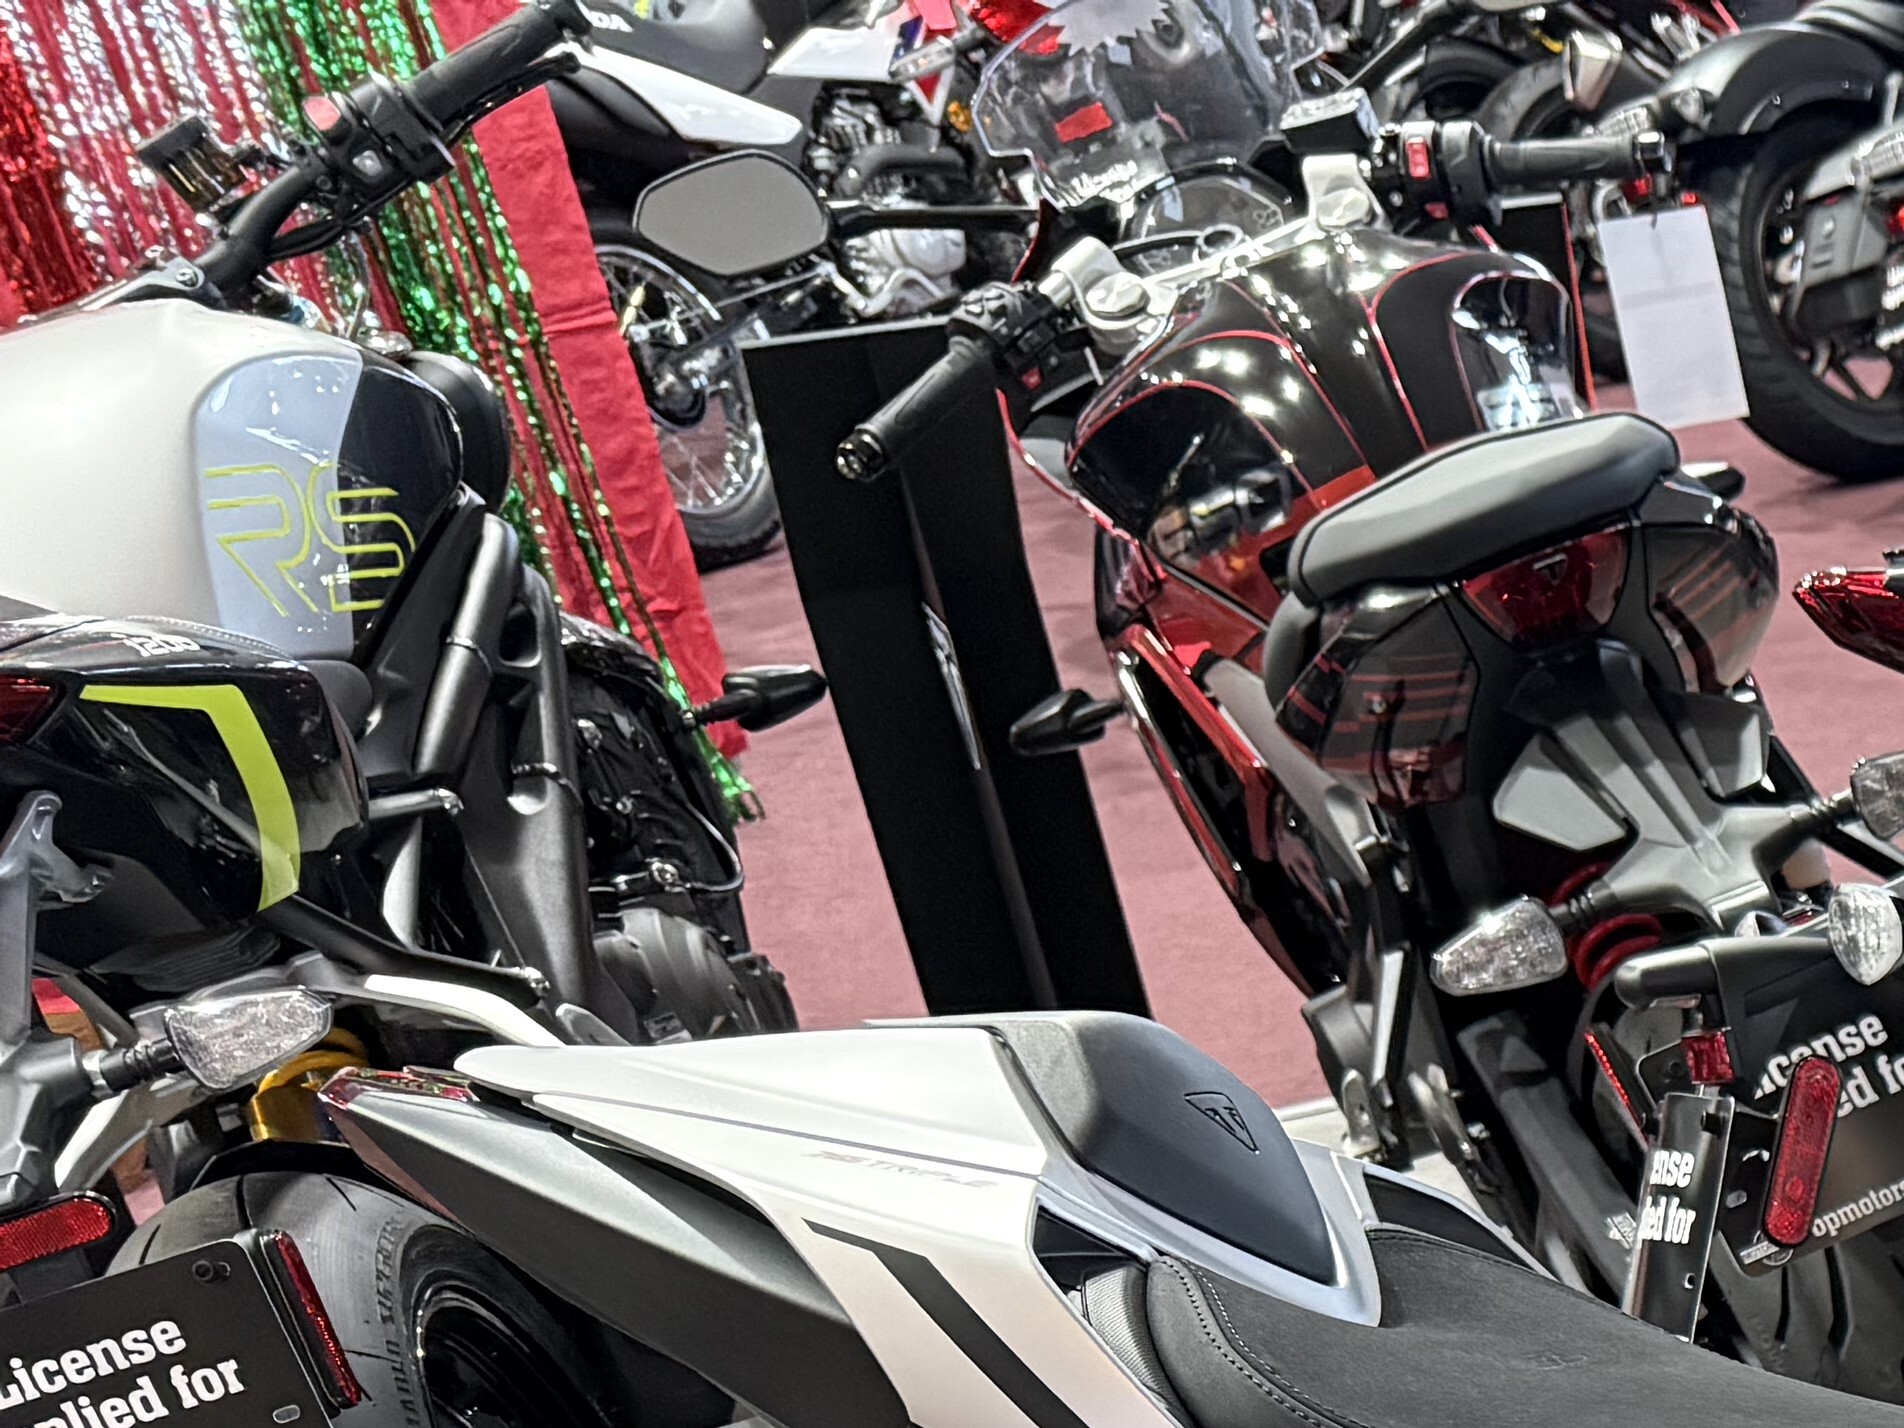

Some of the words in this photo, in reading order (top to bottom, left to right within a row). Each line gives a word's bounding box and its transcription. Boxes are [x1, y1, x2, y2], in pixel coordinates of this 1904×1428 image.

[203, 459, 416, 617] RS
[1669, 1205, 1696, 1245] for
[170, 1359, 245, 1409] for
